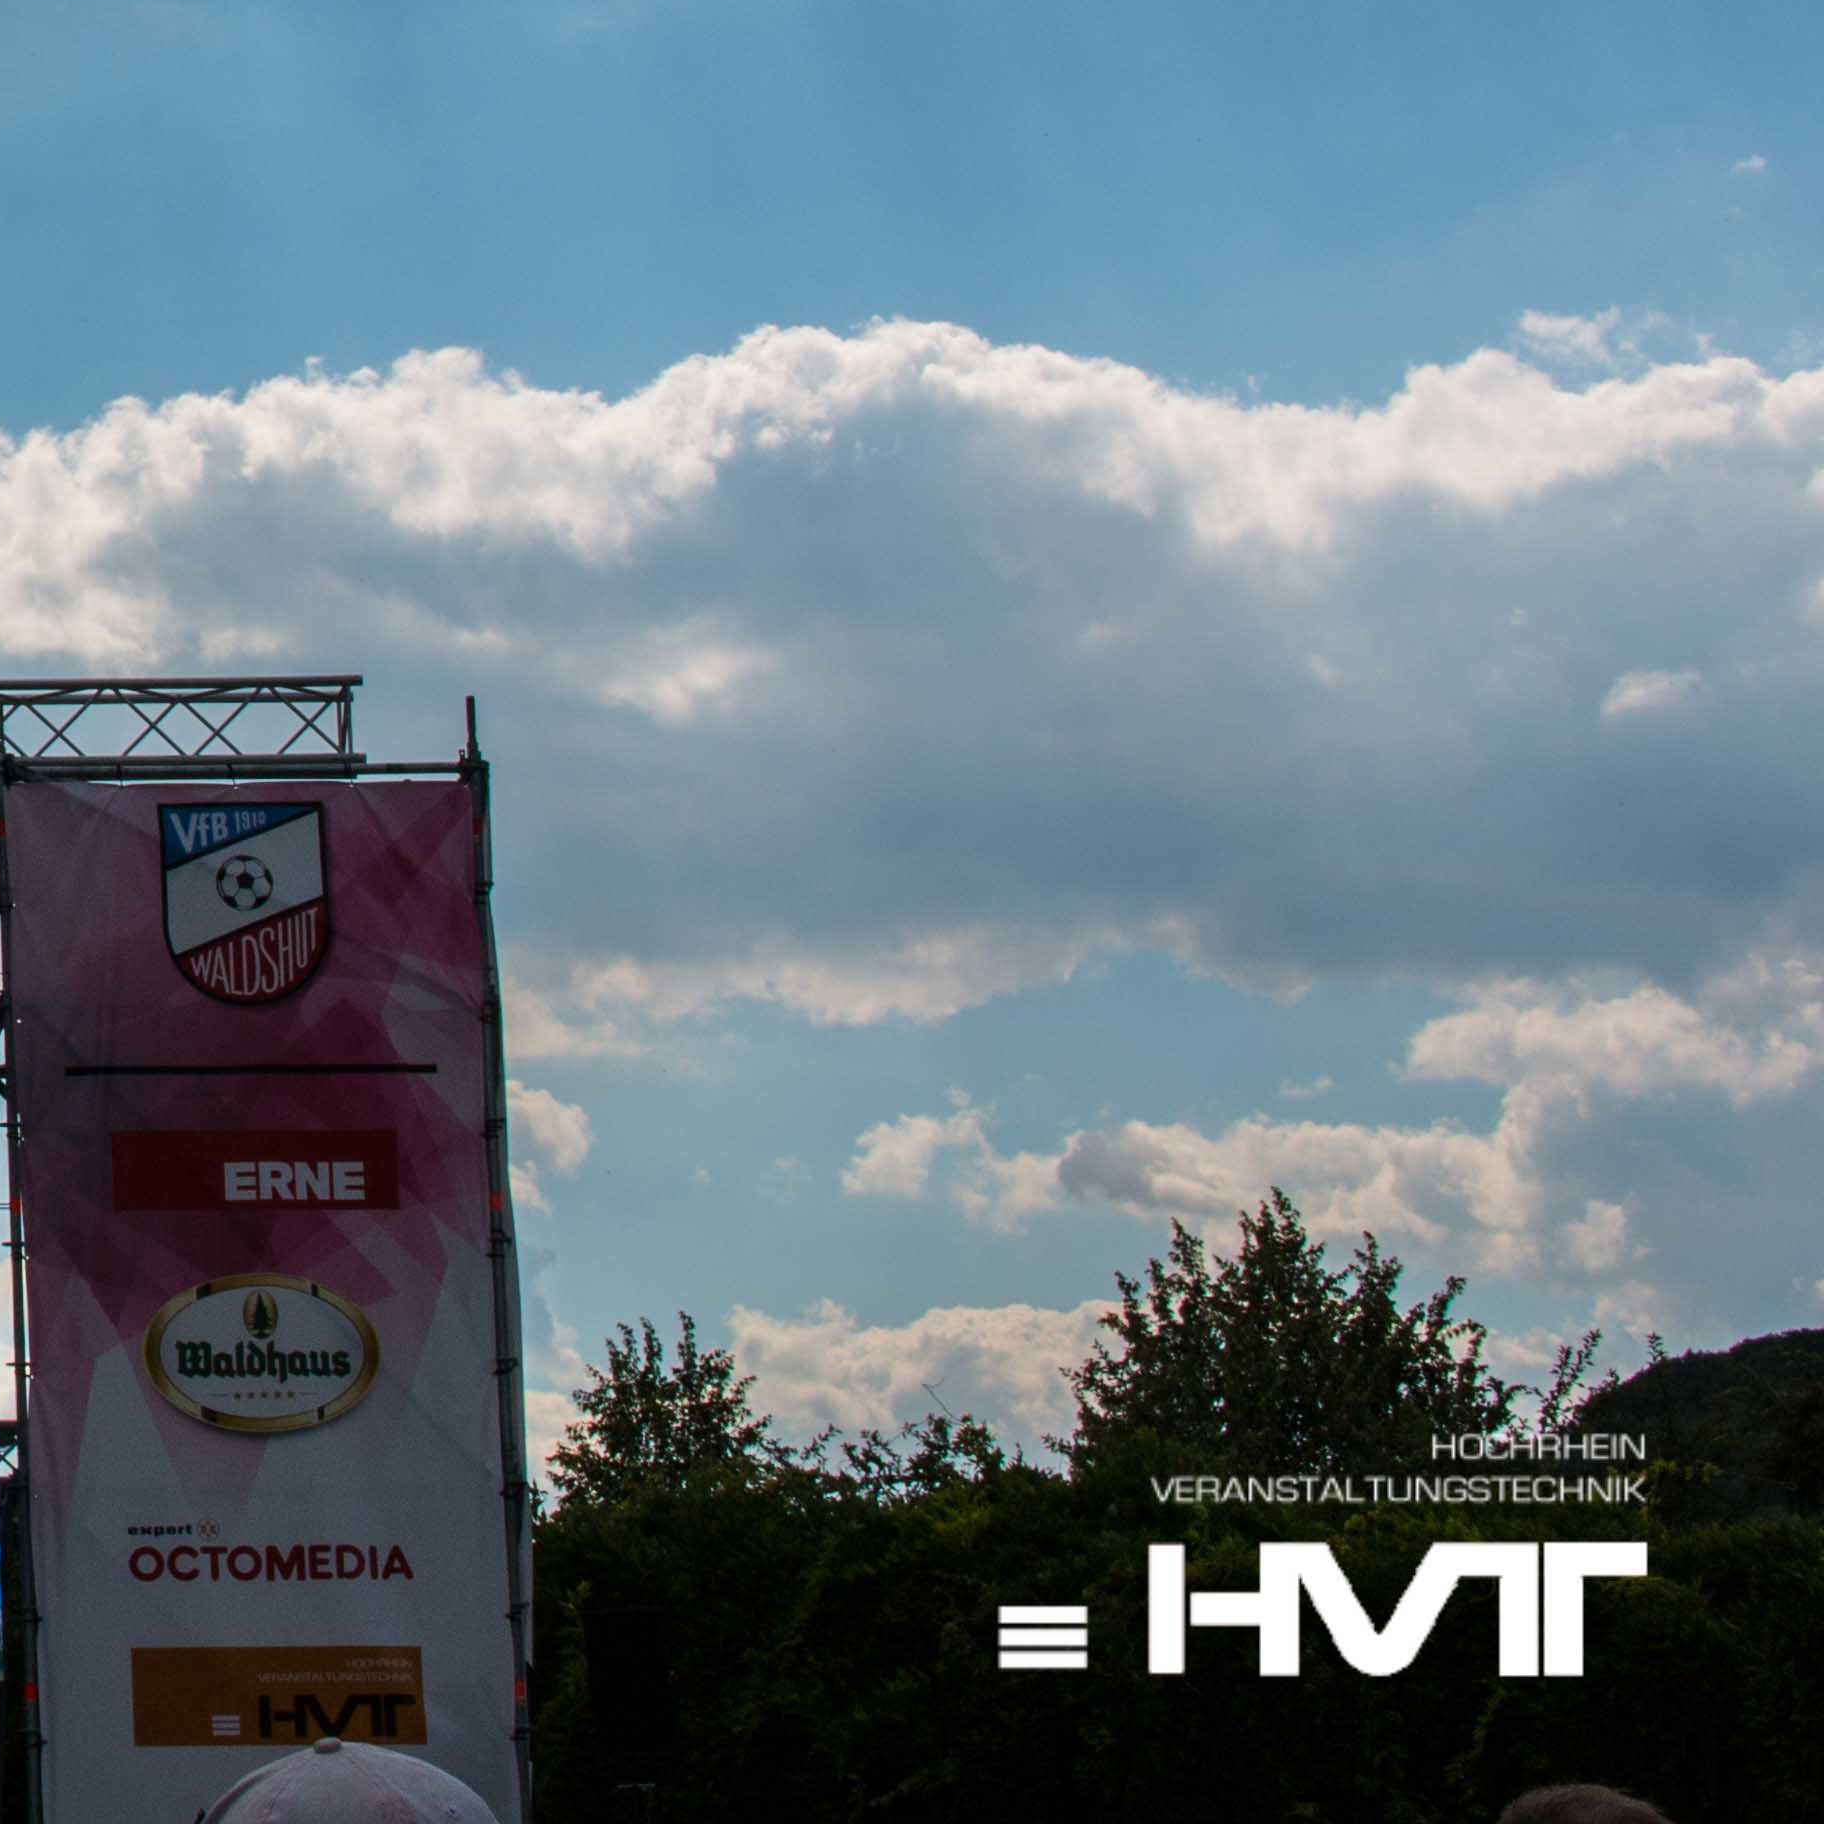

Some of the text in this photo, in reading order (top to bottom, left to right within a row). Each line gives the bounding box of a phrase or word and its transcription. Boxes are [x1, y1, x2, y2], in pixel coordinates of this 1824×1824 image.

[170, 812, 228, 854] VfB
[190, 908, 319, 997] WALDSHUT
[223, 1161, 366, 1202] ERNE
[175, 1340, 352, 1384] Waldhaus
[127, 1523, 194, 1537] expert
[128, 1545, 415, 1582] OCTOMEDIA
[258, 1694, 417, 1738] HVT
